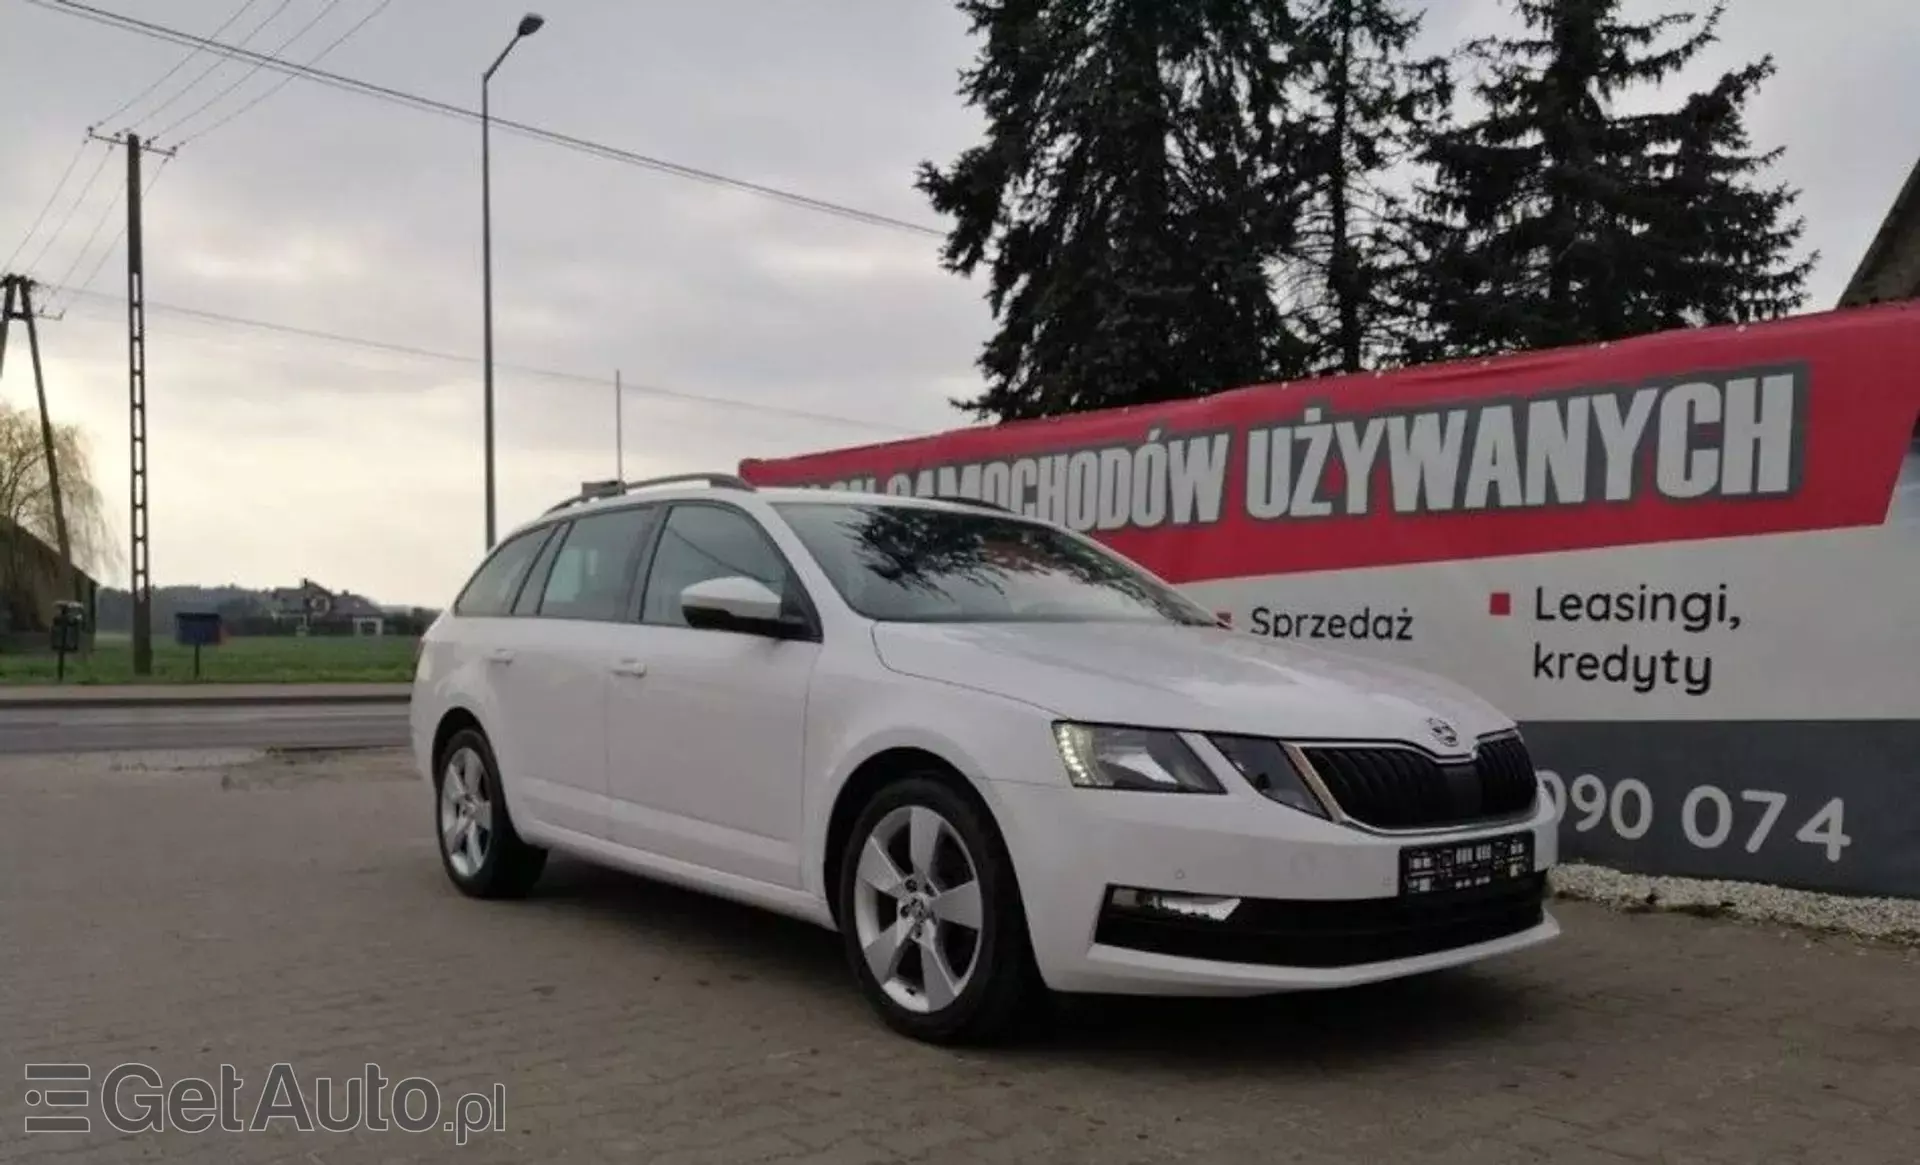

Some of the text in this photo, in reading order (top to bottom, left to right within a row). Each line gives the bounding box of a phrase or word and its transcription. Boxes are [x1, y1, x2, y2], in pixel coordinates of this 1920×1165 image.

[1245, 373, 1795, 520] UŻYWANYCH
[1250, 606, 1414, 641] Sprzedaż
[1534, 583, 1742, 632] Leasingi,
[1533, 643, 1713, 694] kredyty
[1681, 783, 1851, 862] 074
